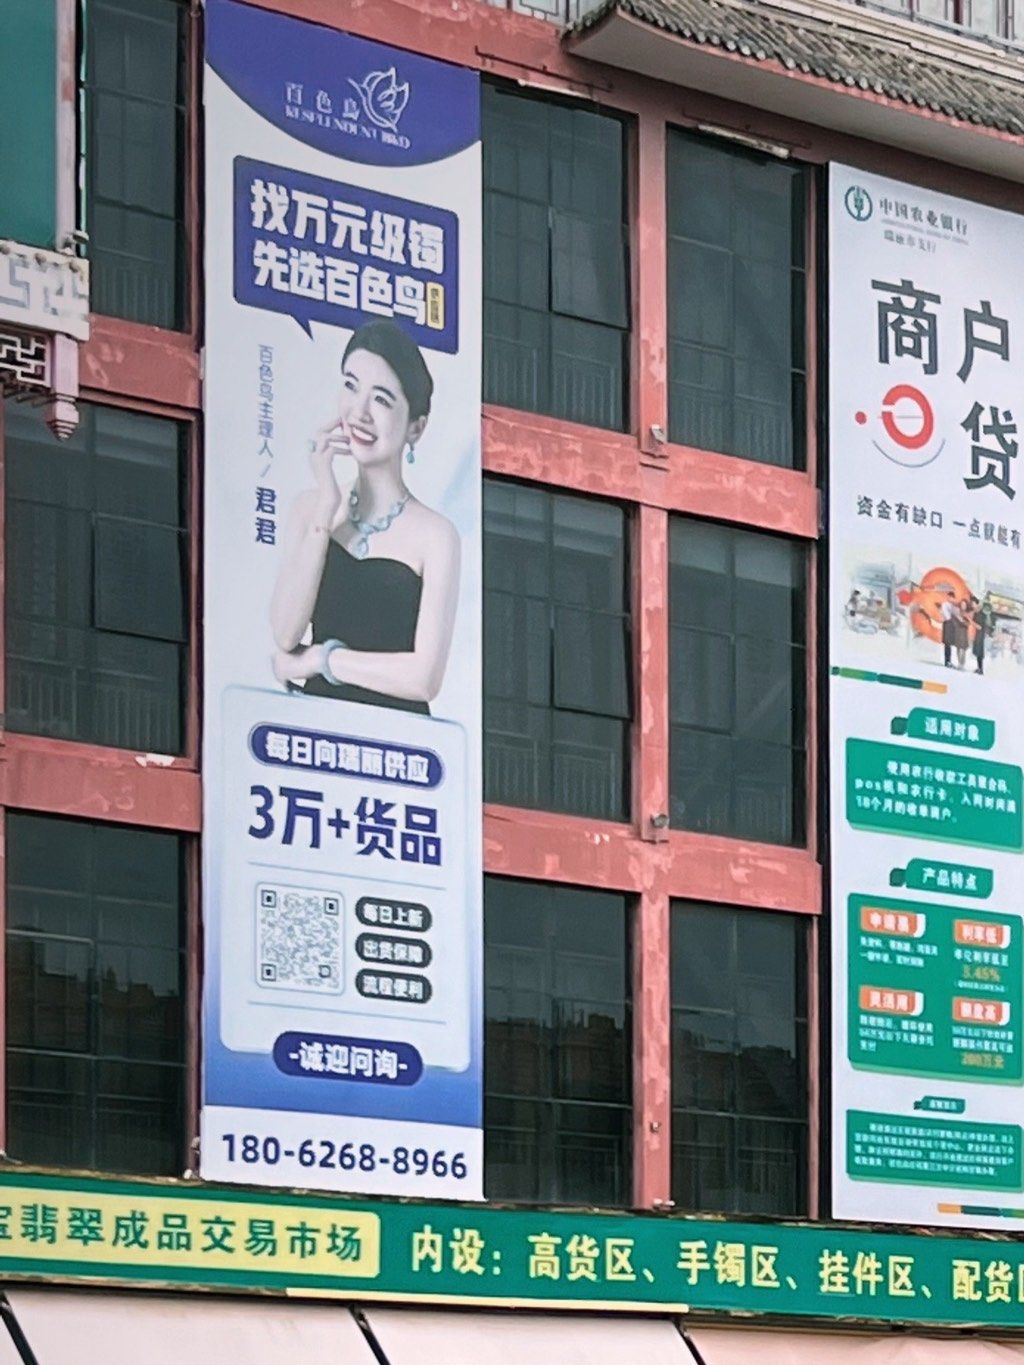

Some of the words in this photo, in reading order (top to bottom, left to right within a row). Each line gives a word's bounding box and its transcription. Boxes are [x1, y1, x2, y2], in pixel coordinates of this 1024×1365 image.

[250, 178, 444, 274] 找万元级镯
[253, 240, 427, 326] 先选百色鸟
[264, 731, 430, 784] 每日向瑞丽供应
[247, 784, 443, 866] 3万+货品
[221, 1133, 468, 1180] 180-6268-8966
